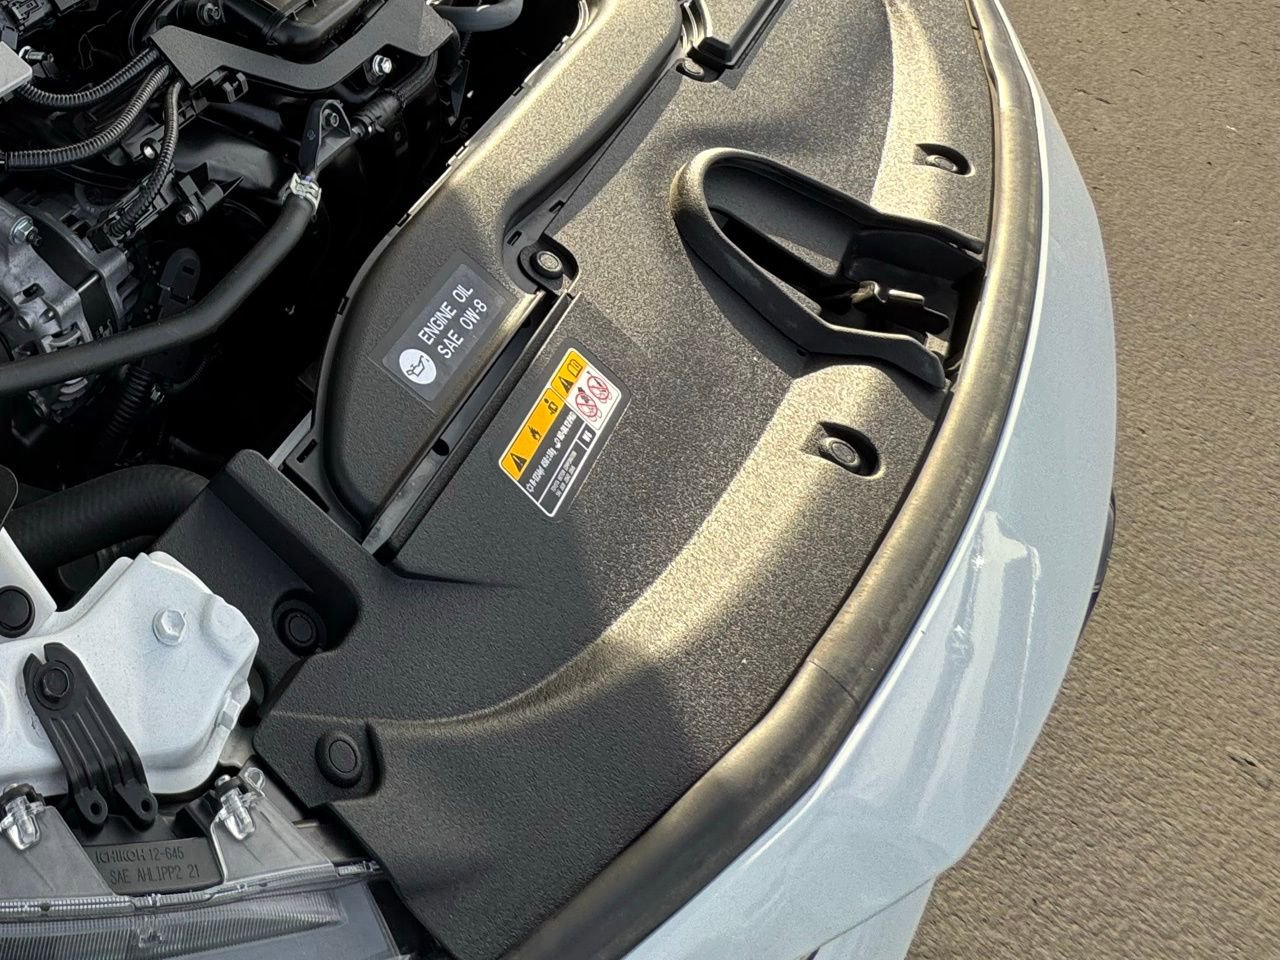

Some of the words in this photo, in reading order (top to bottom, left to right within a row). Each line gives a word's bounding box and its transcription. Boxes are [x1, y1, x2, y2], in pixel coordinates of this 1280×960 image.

[418, 301, 457, 345] ENGINE
[452, 284, 473, 303] OIL
[437, 328, 464, 359] SAE
[459, 298, 487, 330] 0W-8
[109, 868, 130, 885] SAE
[187, 863, 201, 879] 21
[148, 846, 185, 861] 12-645
